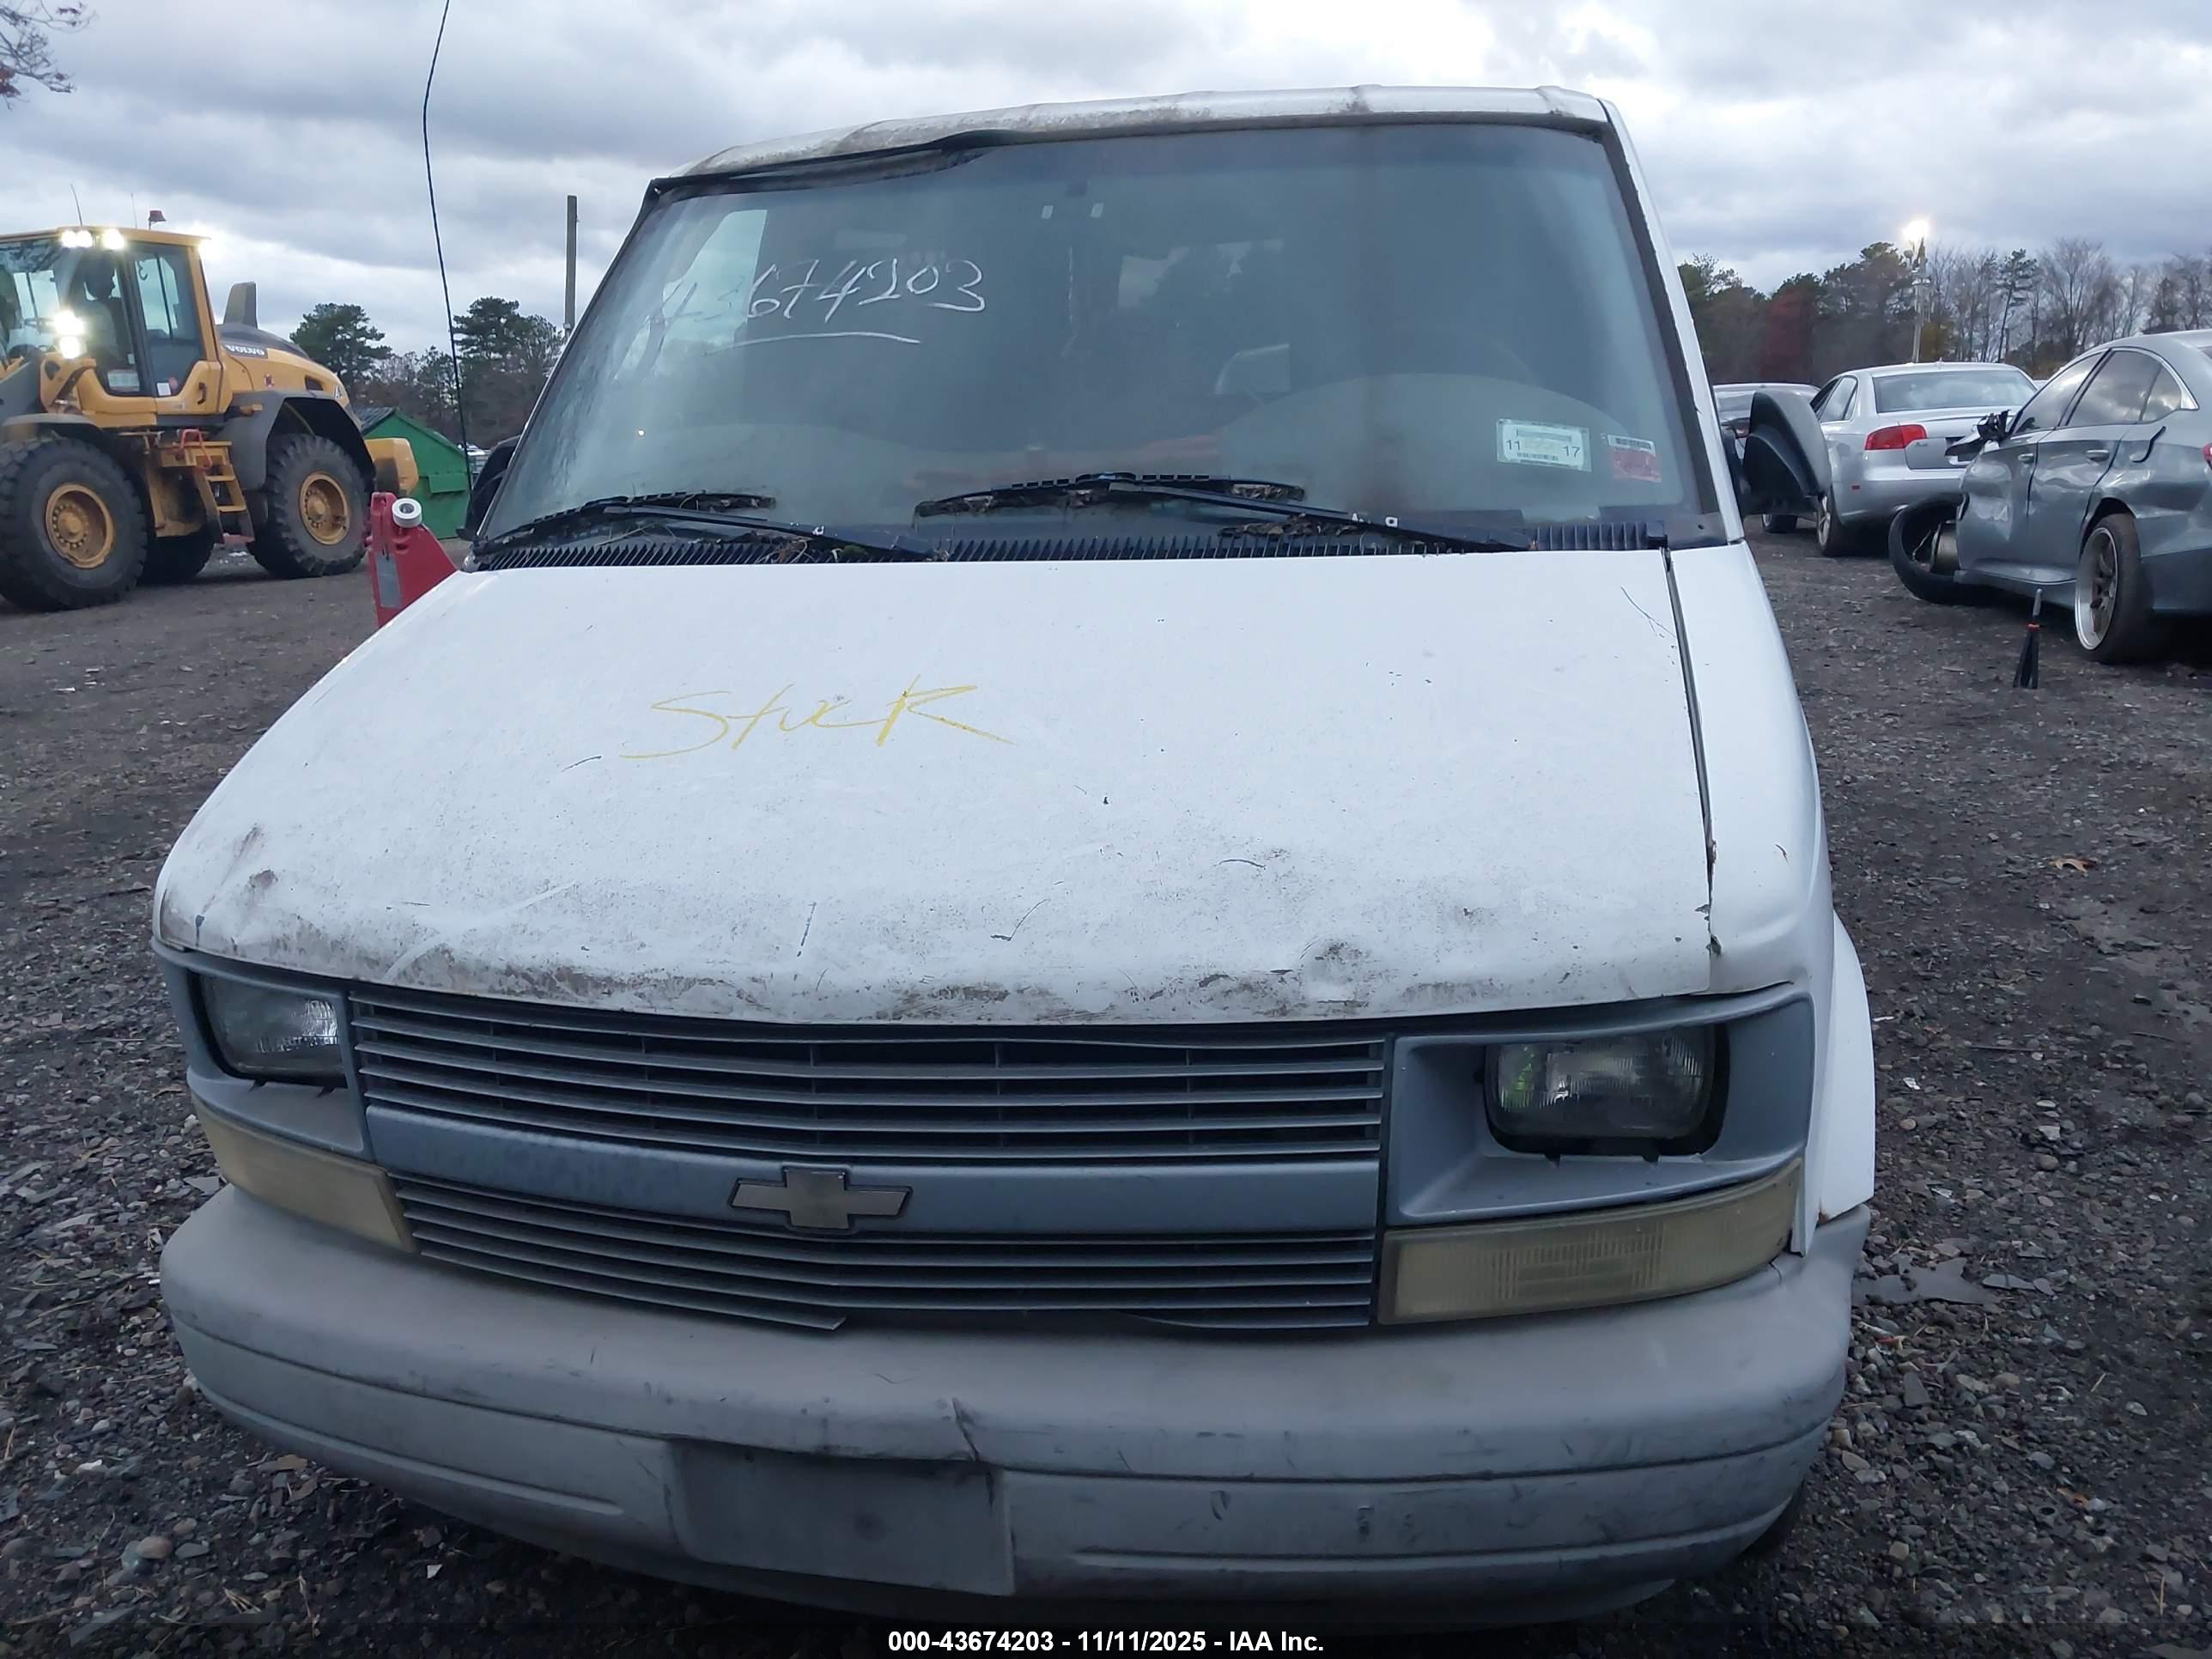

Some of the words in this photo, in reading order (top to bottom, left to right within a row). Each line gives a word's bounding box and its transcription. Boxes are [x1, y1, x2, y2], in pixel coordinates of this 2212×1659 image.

[224, 343, 265, 356] VOLVO
[1505, 439, 1521, 451] 11
[1563, 445, 1581, 458] 17
